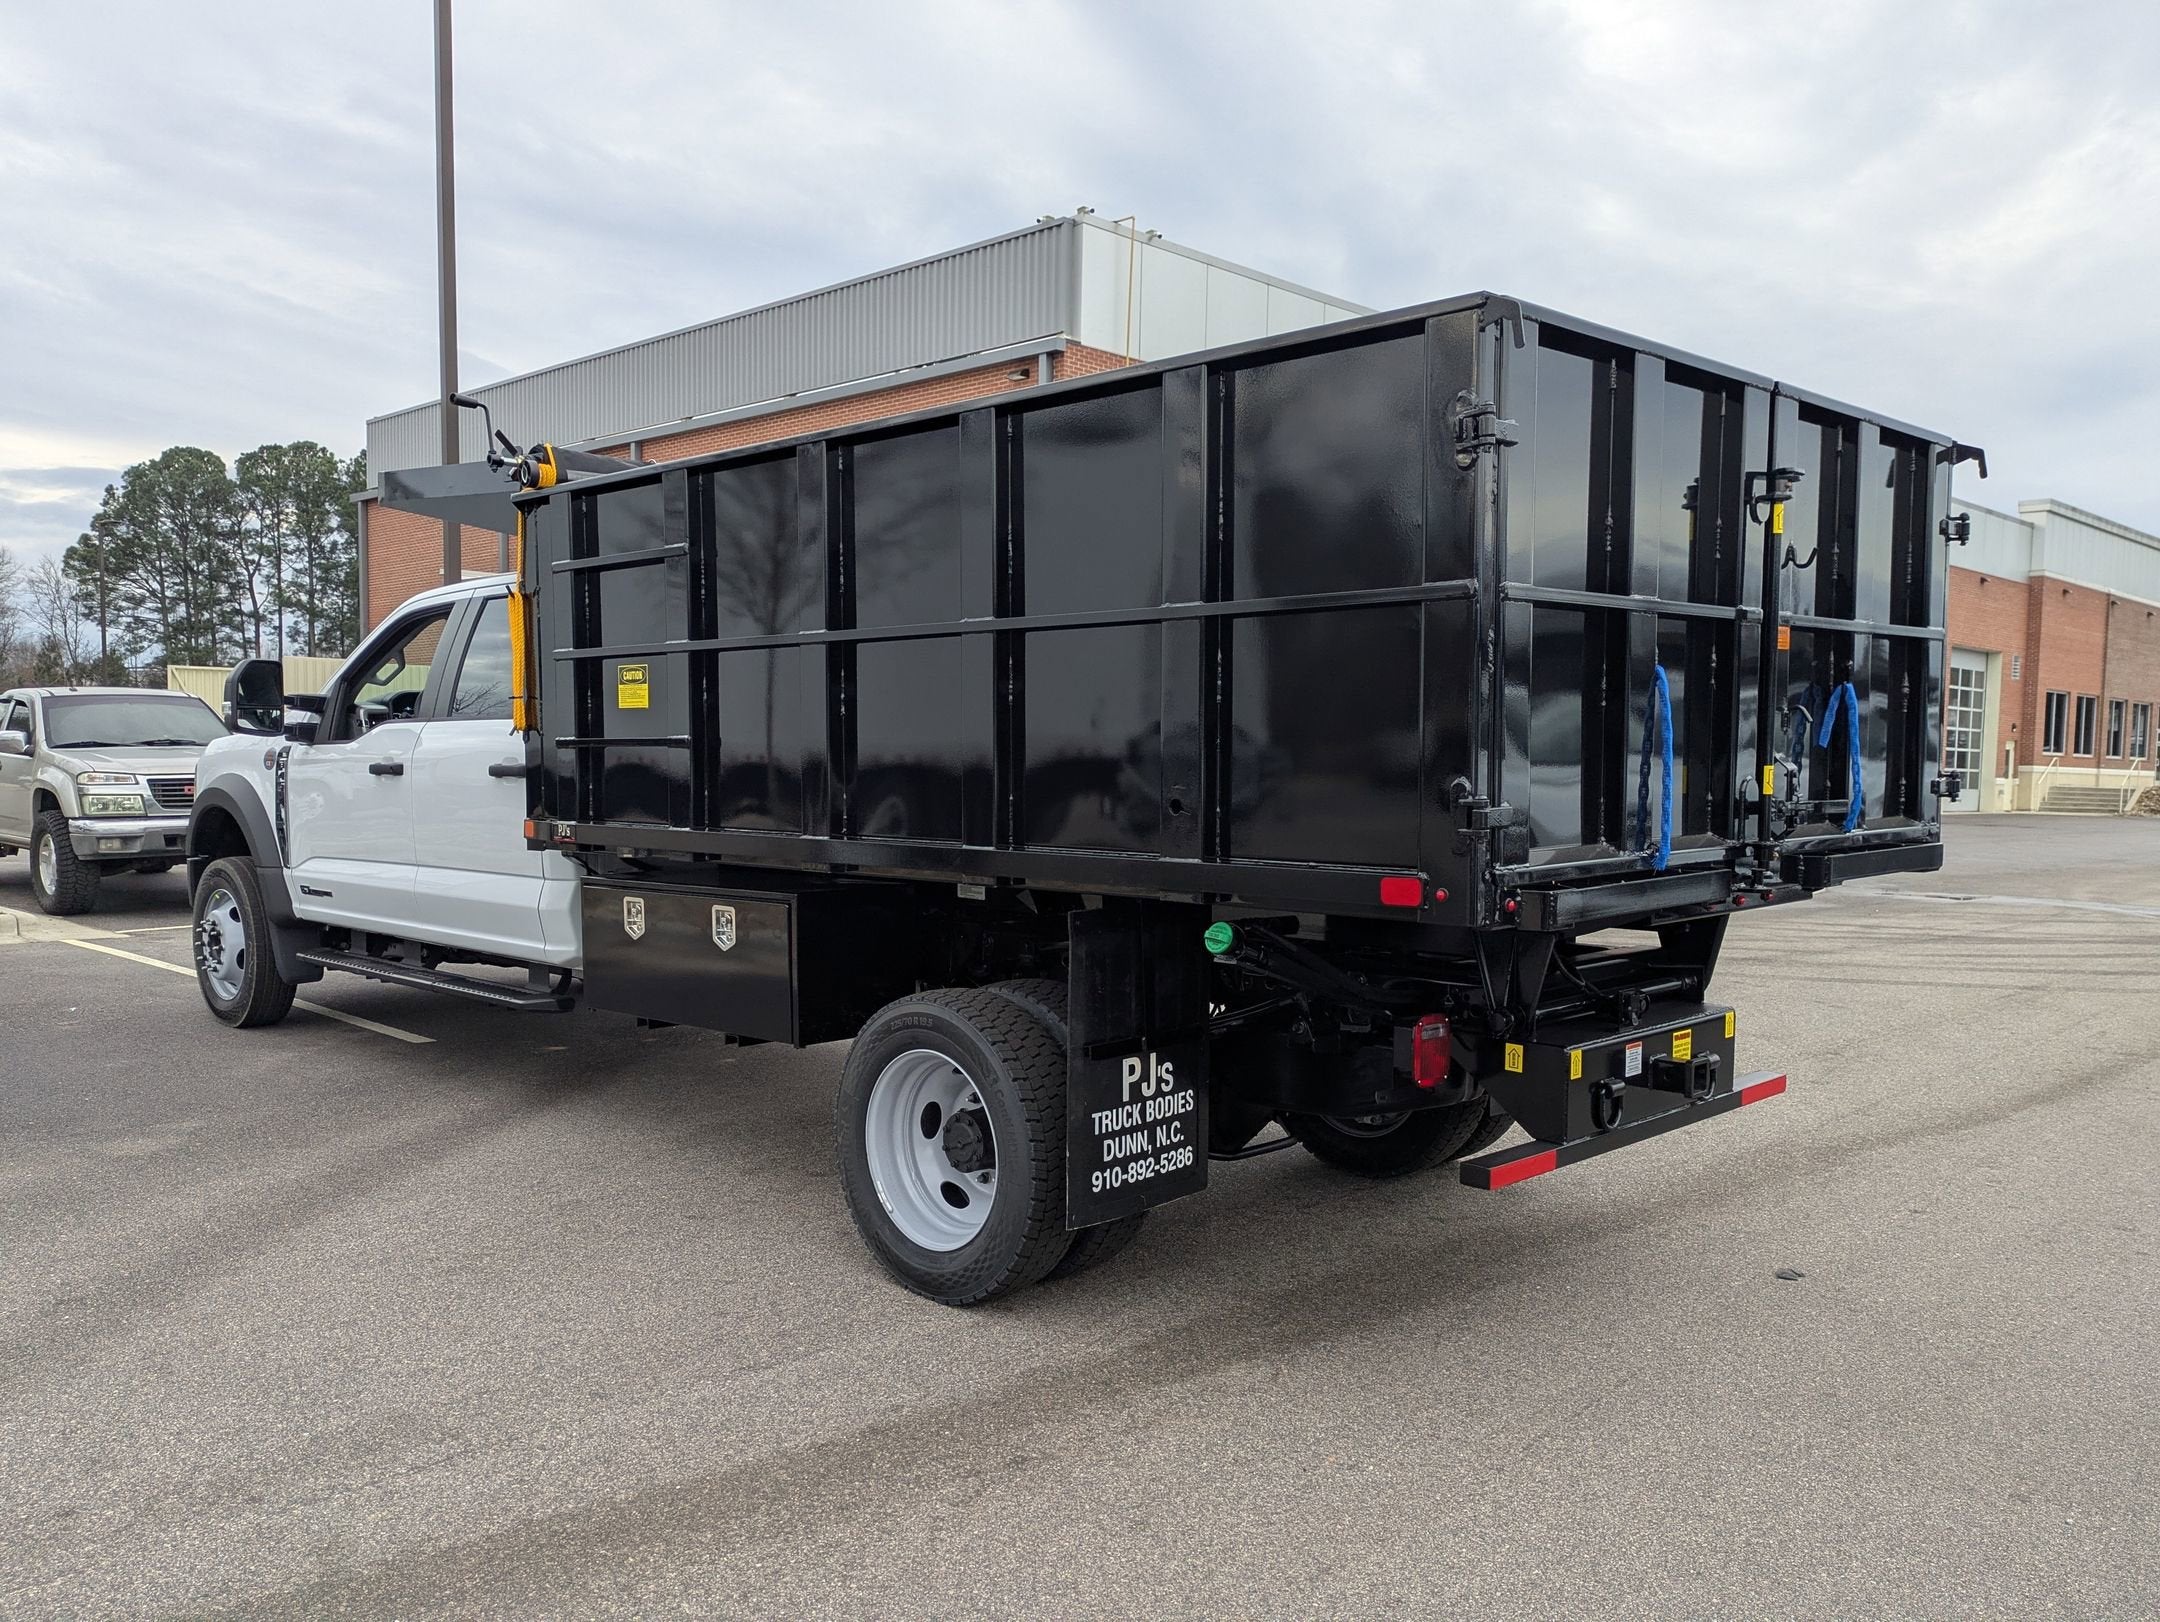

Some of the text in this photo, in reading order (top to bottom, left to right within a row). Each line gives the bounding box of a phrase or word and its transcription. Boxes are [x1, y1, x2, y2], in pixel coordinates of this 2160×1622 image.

[623, 670, 643, 680] CAUTION
[558, 824, 570, 836] PJ's
[1122, 1052, 1174, 1102] PJ's
[1091, 1089, 1194, 1136] TRUCK BODIES
[1103, 1120, 1185, 1162] DUNN, N.C.
[1091, 1145, 1193, 1193] 910-892-5286
